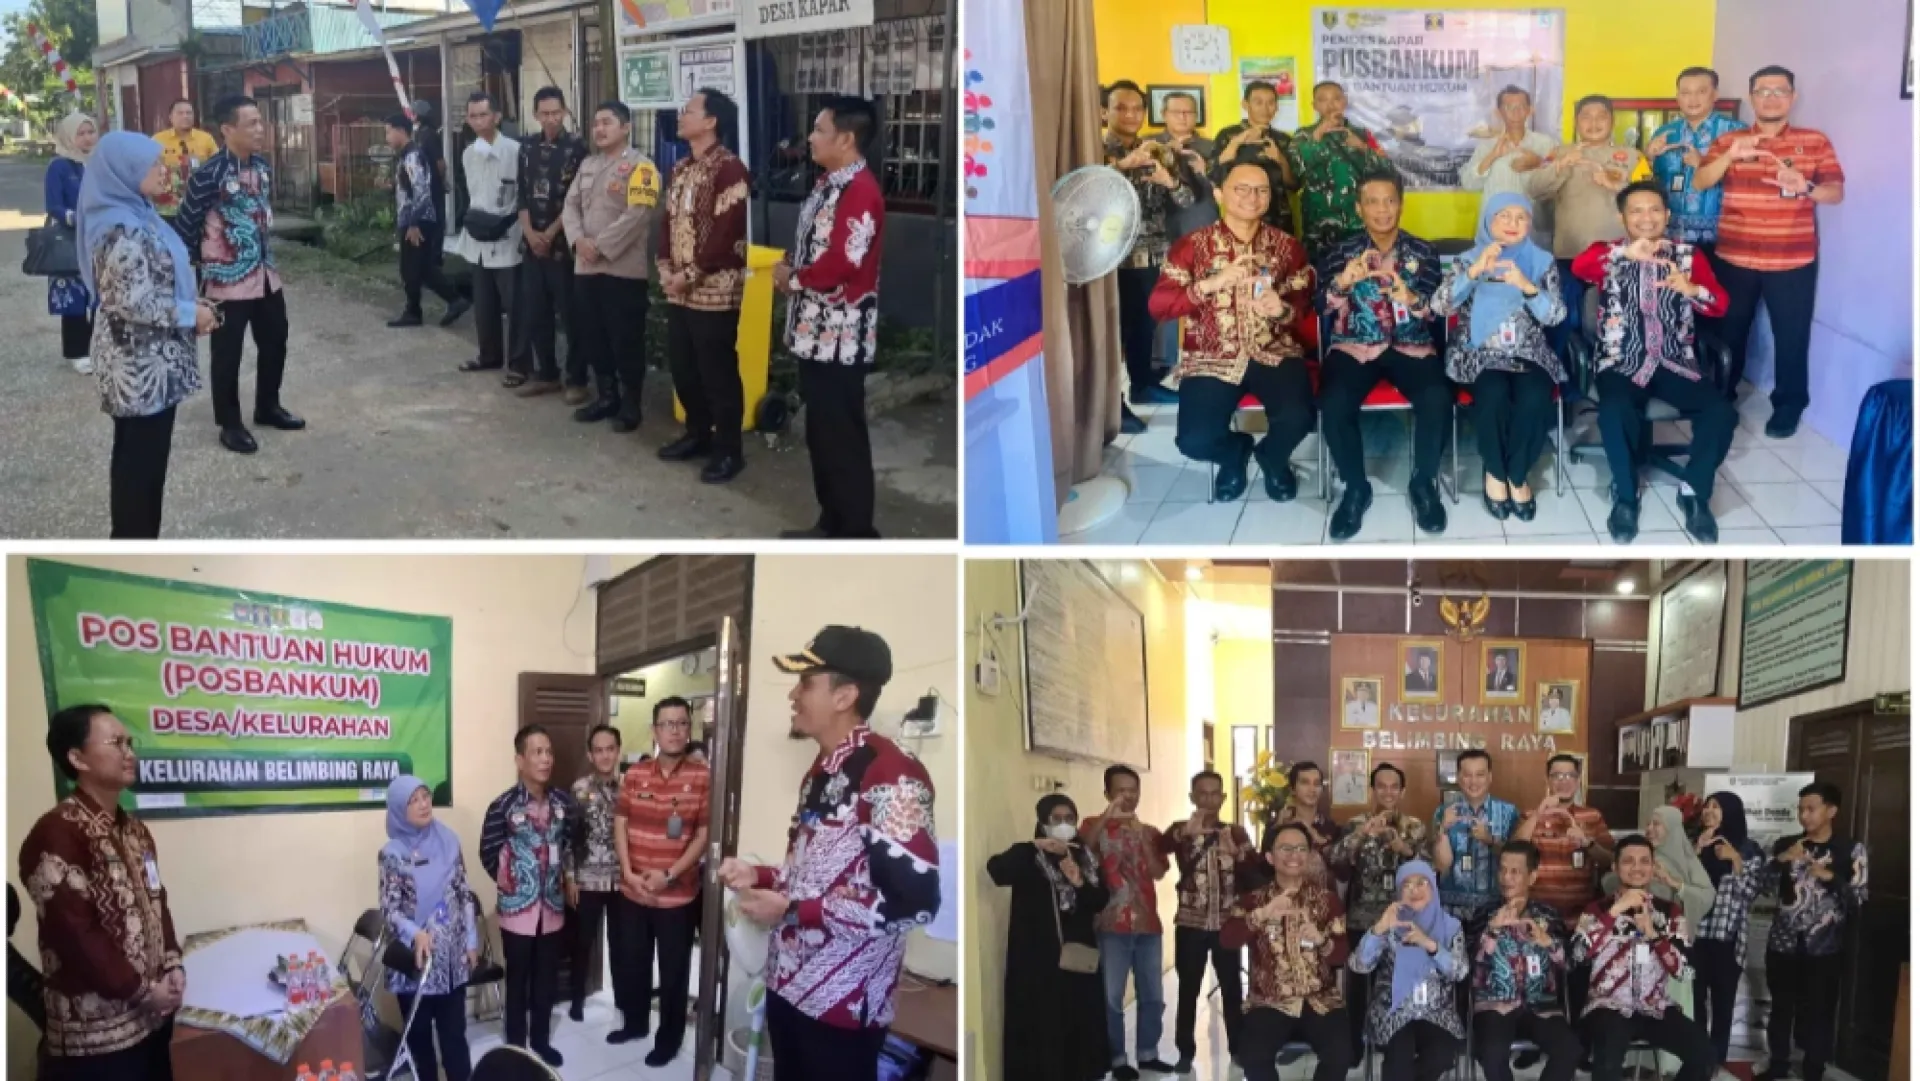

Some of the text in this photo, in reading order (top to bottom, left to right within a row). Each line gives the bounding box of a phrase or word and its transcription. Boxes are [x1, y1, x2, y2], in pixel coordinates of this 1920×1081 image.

[758, 0, 851, 24] DESA KAPAR
[1321, 47, 1480, 80] POSBANKUM
[81, 614, 430, 673] POS BANTUAN HUKUM
[163, 661, 380, 706] (POSBANKUM)
[152, 706, 390, 737] DESA/KELURAHAN
[1388, 702, 1533, 723] KELURAHAN
[1362, 730, 1557, 752] BELIMBING RAYA
[139, 758, 400, 783] KELURAHAN BELIMBING RAYA
